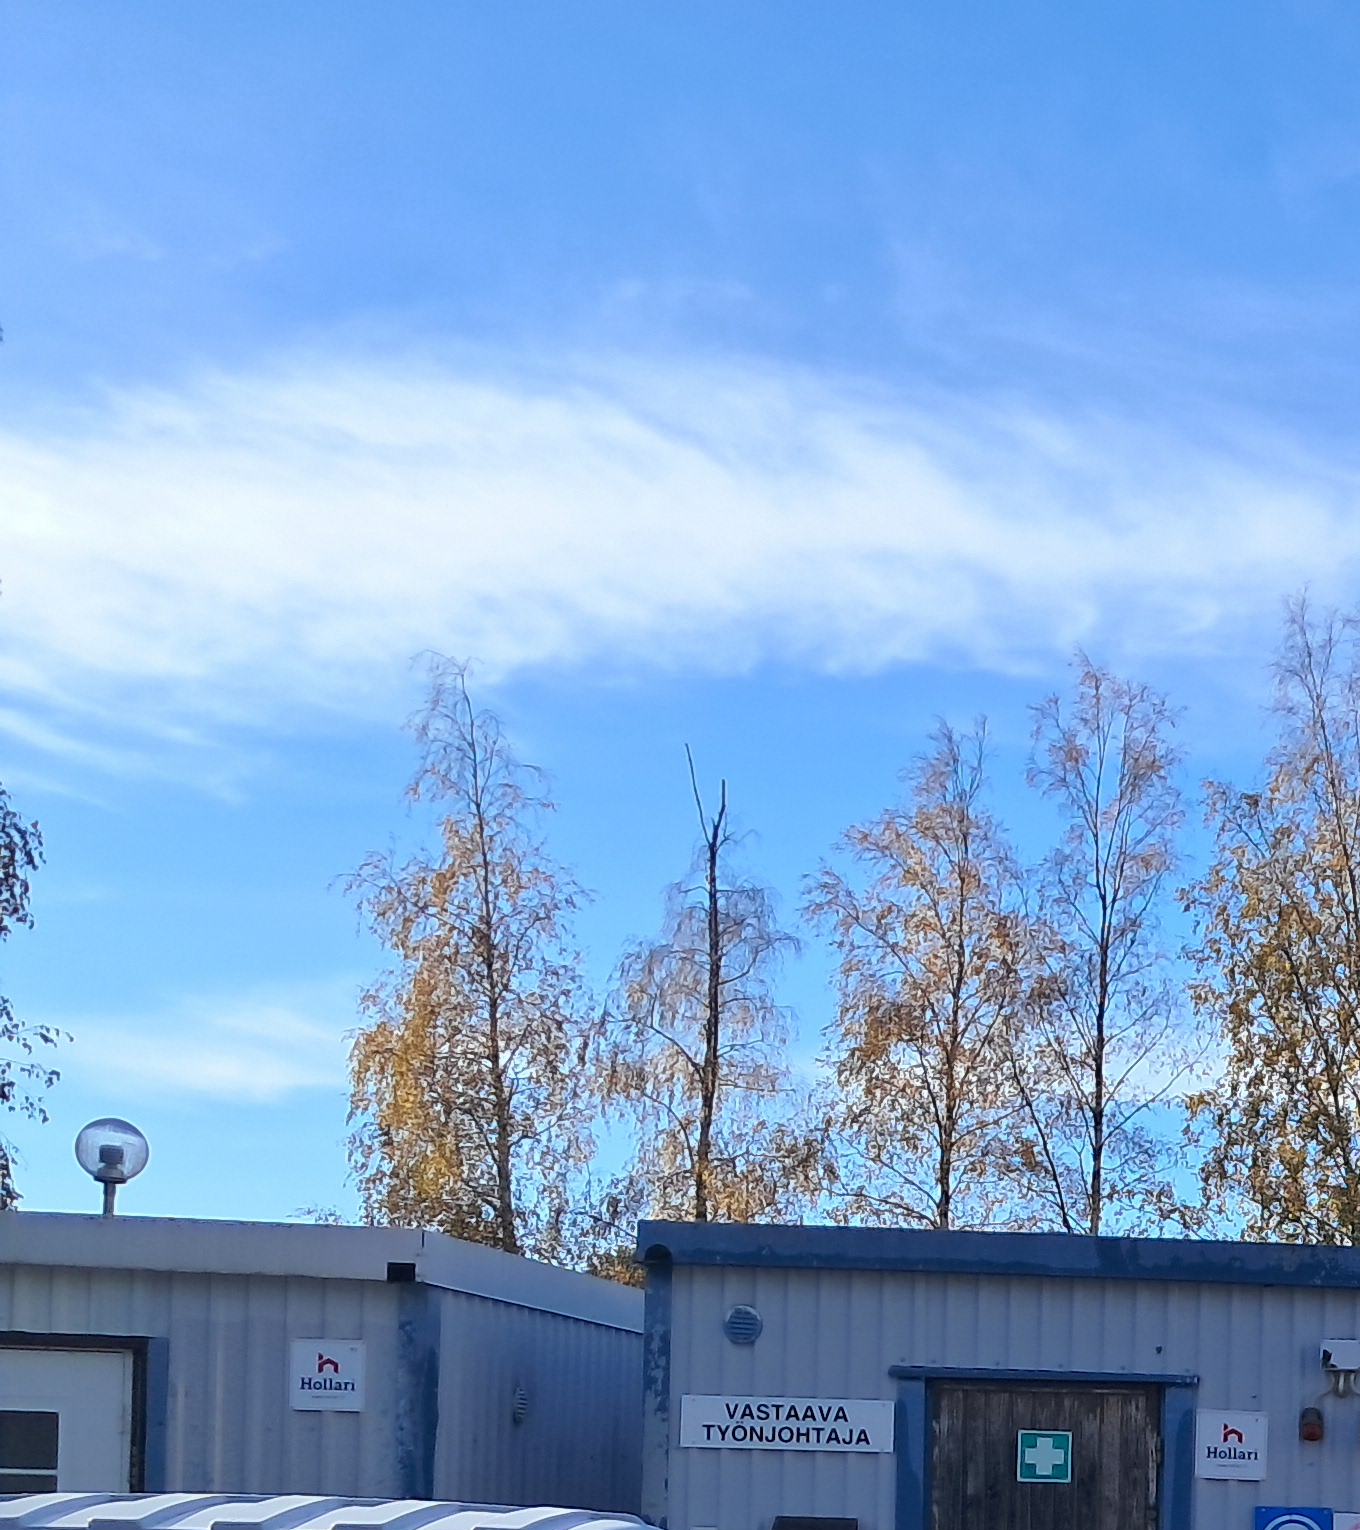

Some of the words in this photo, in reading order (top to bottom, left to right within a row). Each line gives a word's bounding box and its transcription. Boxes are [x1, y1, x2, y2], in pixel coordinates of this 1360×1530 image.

[300, 1376, 356, 1392] Hollari
[725, 1402, 849, 1422] VASTAAVA
[702, 1421, 871, 1446] TYÖNJOHTAJA
[1206, 1445, 1259, 1461] Hollari
